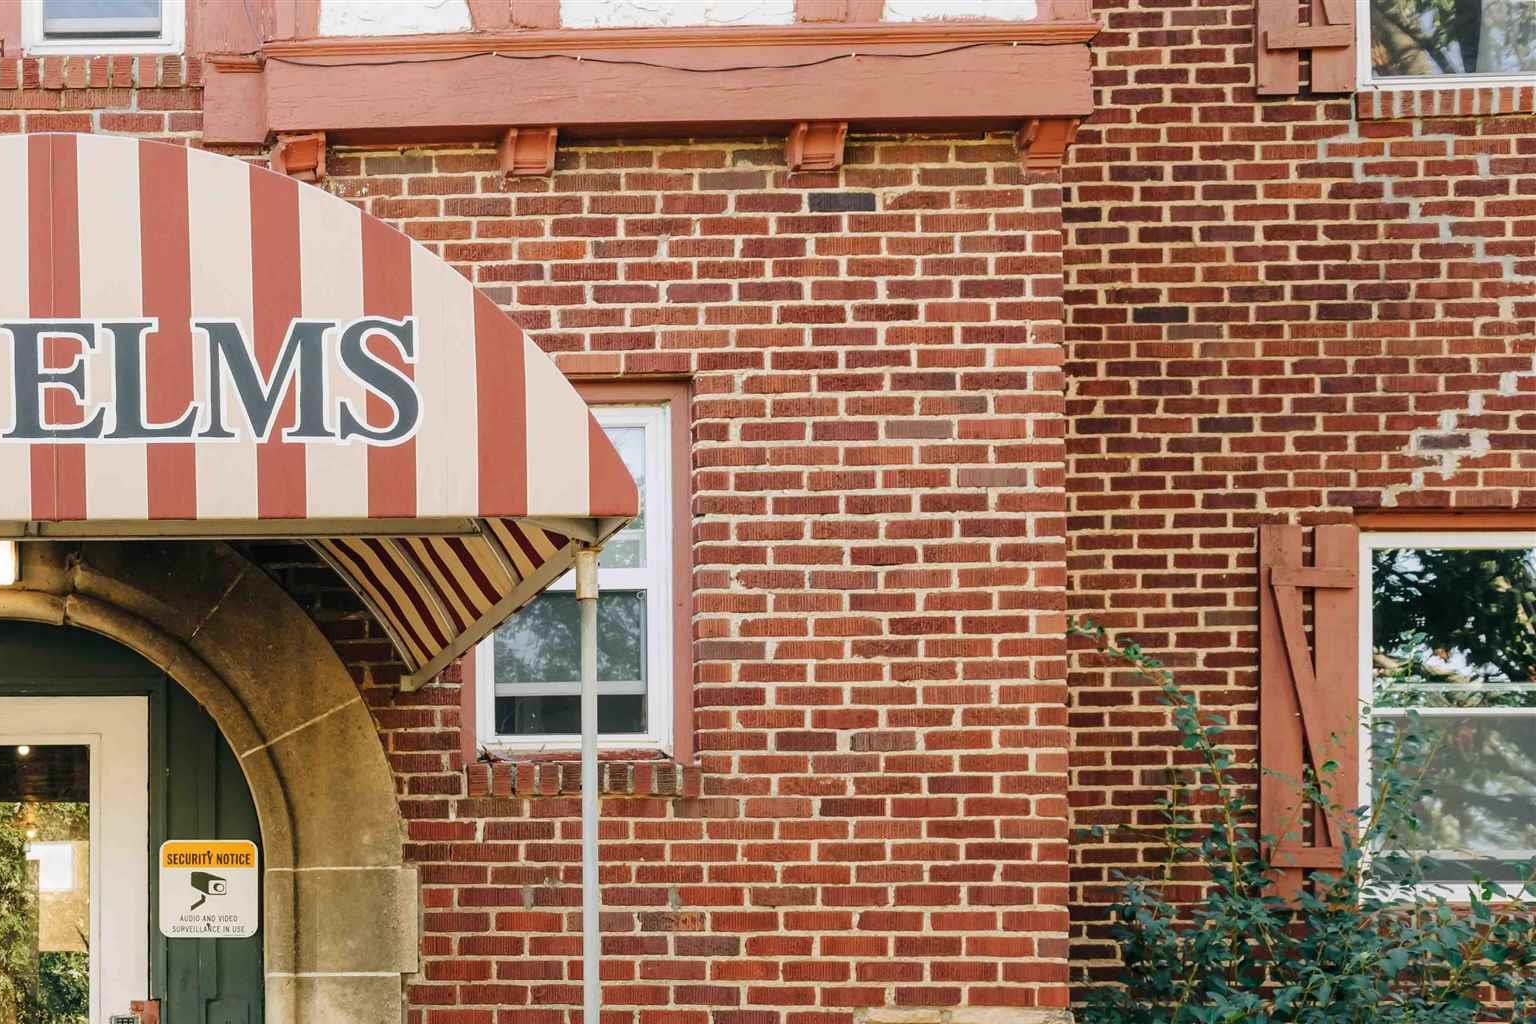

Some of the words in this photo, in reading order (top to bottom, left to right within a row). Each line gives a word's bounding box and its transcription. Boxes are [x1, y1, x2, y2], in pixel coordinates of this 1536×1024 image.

[167, 853, 213, 865] SECURITY
[216, 853, 251, 865] NOTICE
[180, 914, 201, 922] AUDIO
[202, 914, 216, 922] AND
[218, 914, 238, 922] VIDEO
[172, 925, 220, 933] SURVEILLANCE
[223, 925, 230, 933] IN
[232, 925, 245, 933] USE
